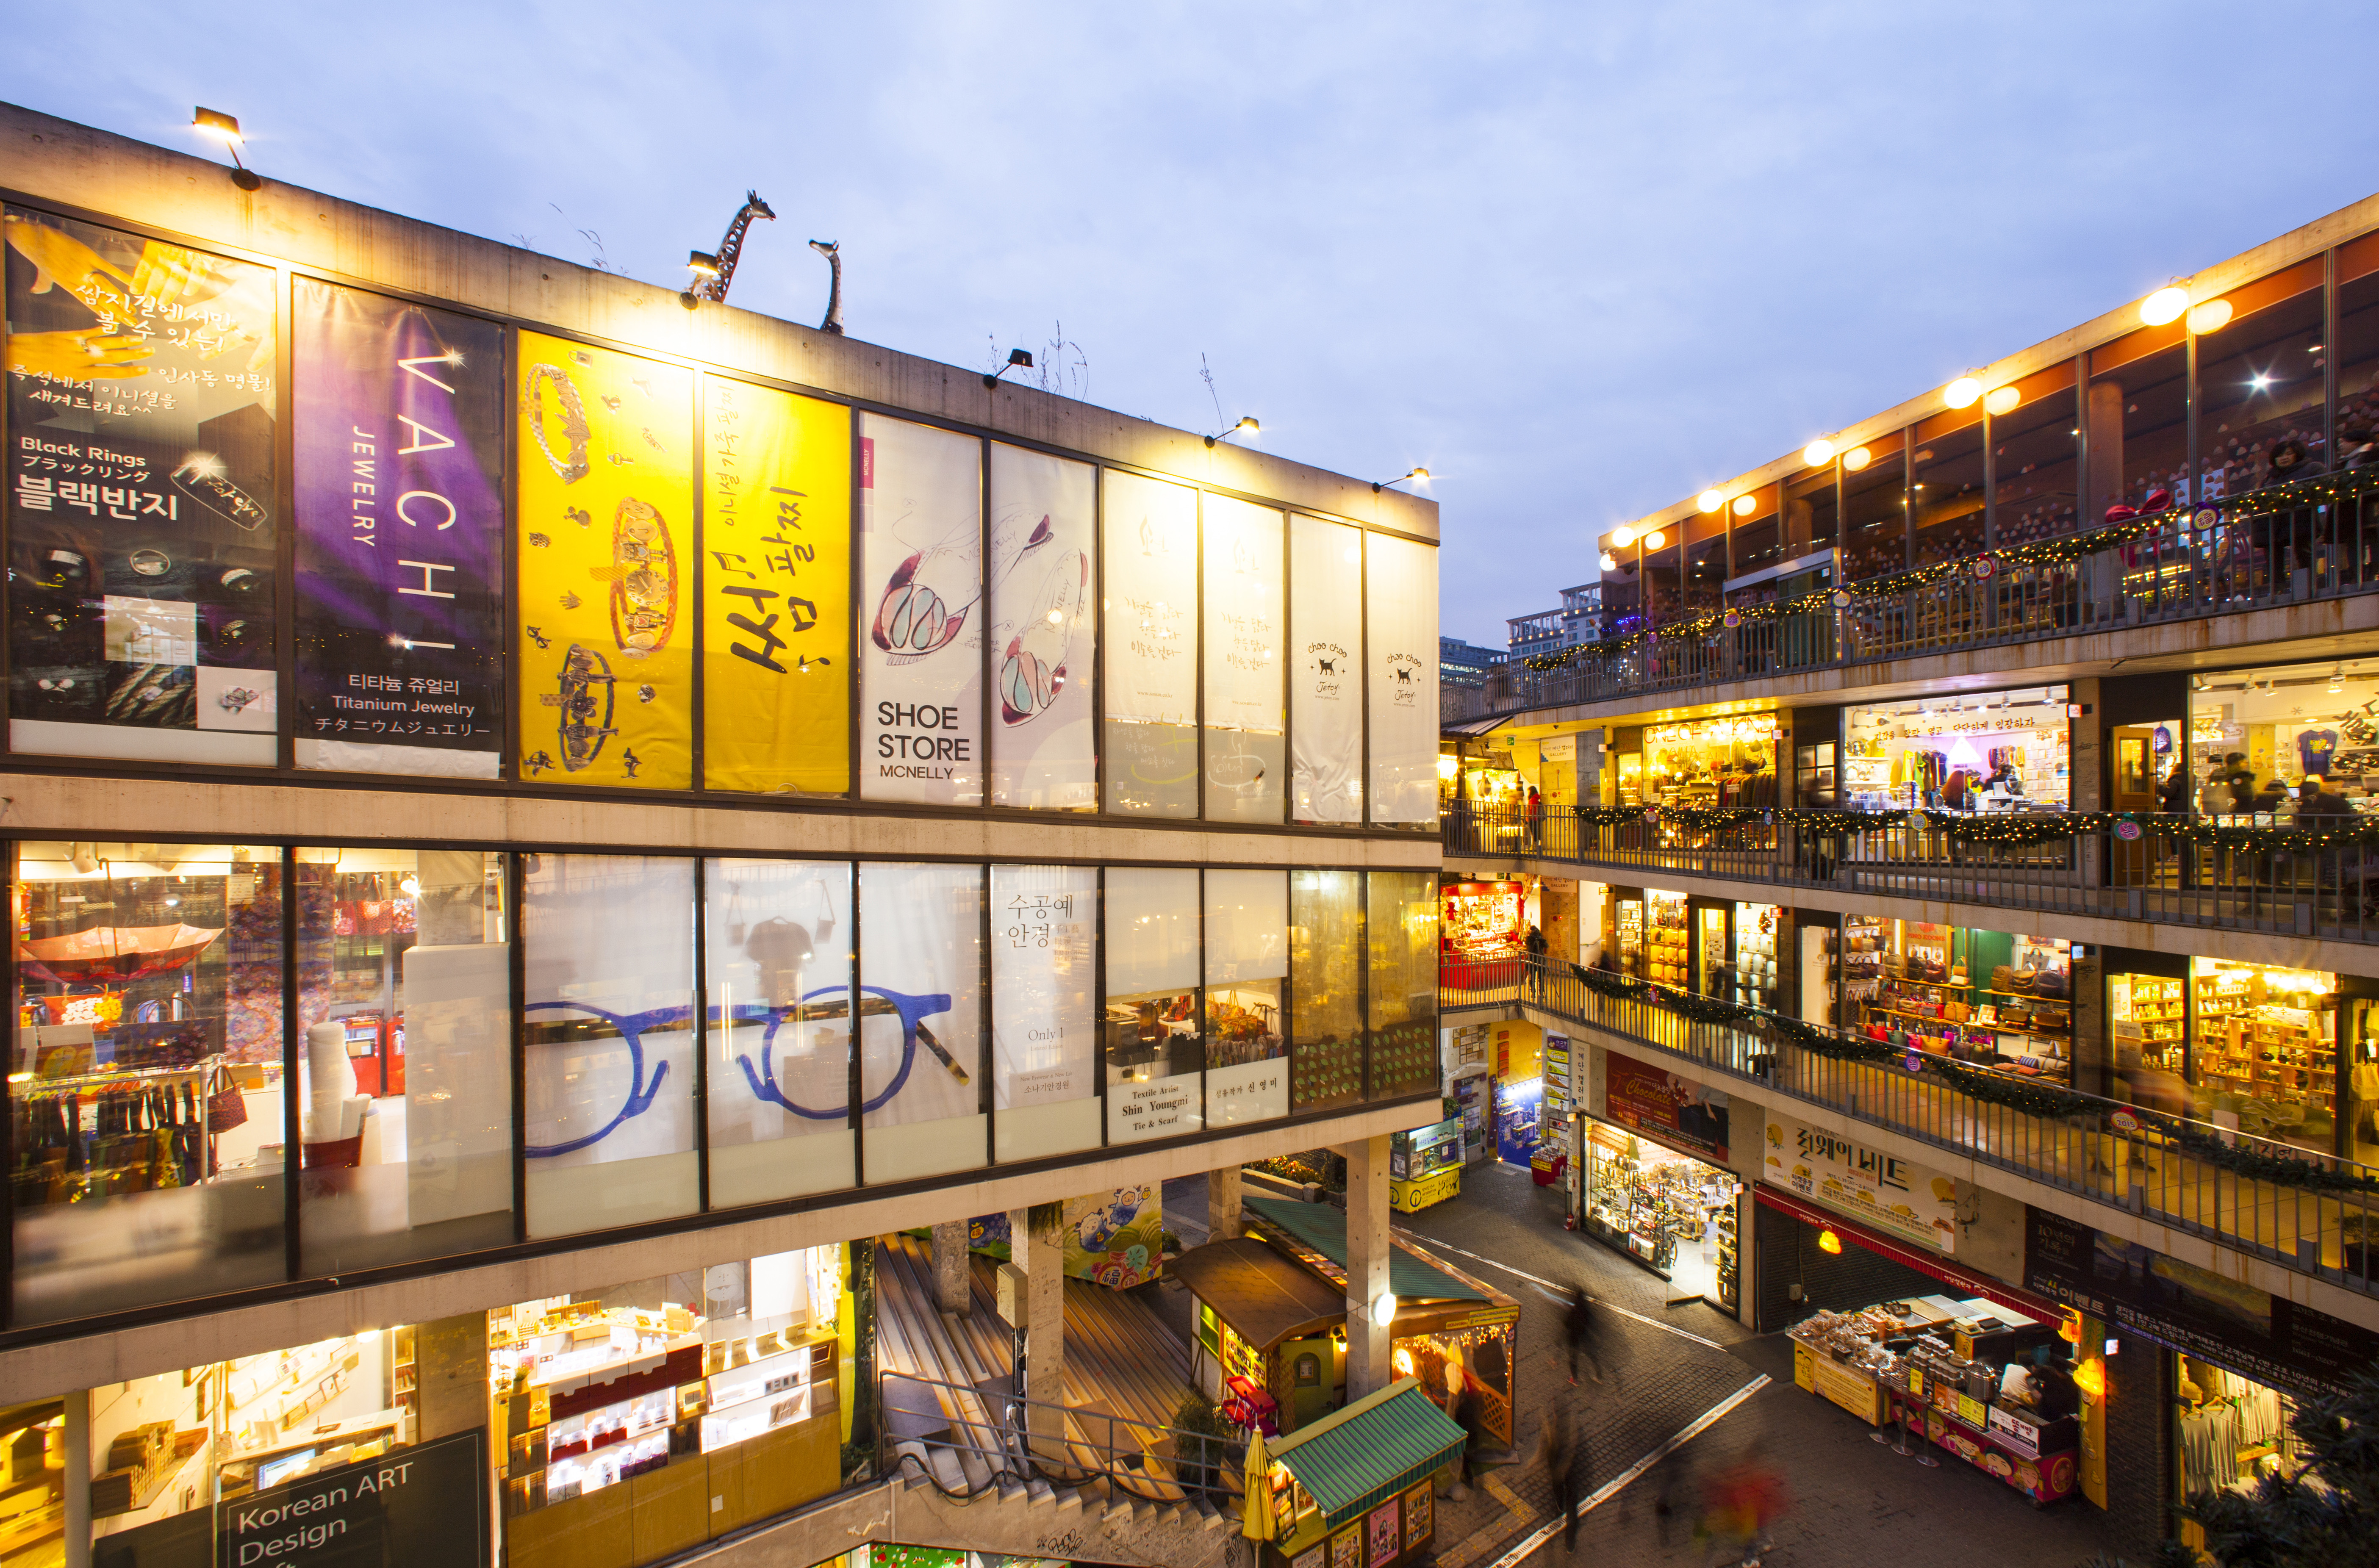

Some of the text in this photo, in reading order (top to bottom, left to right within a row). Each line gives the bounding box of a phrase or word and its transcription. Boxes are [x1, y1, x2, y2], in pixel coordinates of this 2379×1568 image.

[96, 310, 224, 352] 볼 수 있는!
[158, 367, 271, 392] 인사동 명물!
[101, 385, 177, 410] 이니셜을
[21, 437, 146, 467] Black Rings
[717, 430, 740, 467] 가죽
[21, 455, 151, 483] ブラックリング
[15, 475, 177, 520] 블랙반지
[353, 425, 375, 547] JEWELRY
[397, 355, 457, 649] VACHI
[719, 471, 740, 527] 이니셜
[2197, 513, 2213, 526] 福
[1309, 643, 1347, 658] choo choo
[1387, 653, 1422, 668] choo choo
[349, 674, 459, 695] 티타늄 쥬얼리
[1316, 681, 1339, 695] Jetoy
[332, 695, 475, 718] Titanium Jewelry
[1395, 690, 1414, 703] Jetoy
[316, 718, 490, 736] チタニウムジュエリー
[878, 701, 958, 731] SHOE
[1619, 732, 1635, 740] ONLY
[1874, 717, 2035, 741] 지갑을 열고 당당하게 입장하자
[878, 734, 970, 762] STORE
[880, 765, 954, 780] MCNELLY
[1008, 894, 1072, 919] 수공예
[1009, 923, 1049, 947] 안경
[1029, 1027, 1063, 1042] Only 1
[1024, 1080, 1069, 1093] 소나기안경원
[1132, 1086, 1178, 1099] Textile Artist
[1216, 1086, 1243, 1099] 섬유작가
[1626, 1080, 1672, 1105] Chocolate
[1123, 1095, 1188, 1117] Shin Youngmi
[1134, 1122, 1145, 1130] Tie
[1159, 1115, 1178, 1125] Scarf
[1797, 1127, 1909, 1191] 런웨이 비트
[1791, 1181, 1813, 1195] 이벤트
[2038, 1224, 2075, 1247] 10년의
[1102, 1269, 1121, 1285] 福
[1124, 1276, 1134, 1287] 福
[2058, 1287, 2107, 1316] 이벤트
[2132, 1327, 2152, 1340] 2015년
[2138, 1319, 2147, 1327] 1인
[2149, 1322, 2160, 1332] 2매
[2137, 1312, 2156, 1324] 블로그
[2159, 1320, 2185, 1335] 이벤트에
[2187, 1331, 2223, 1349] 참여해주신
[2226, 1346, 2256, 1363] 고객님께
[2292, 1371, 2318, 1386] 10년의
[239, 1462, 413, 1535] Korean ART
[239, 1518, 347, 1567] Design
